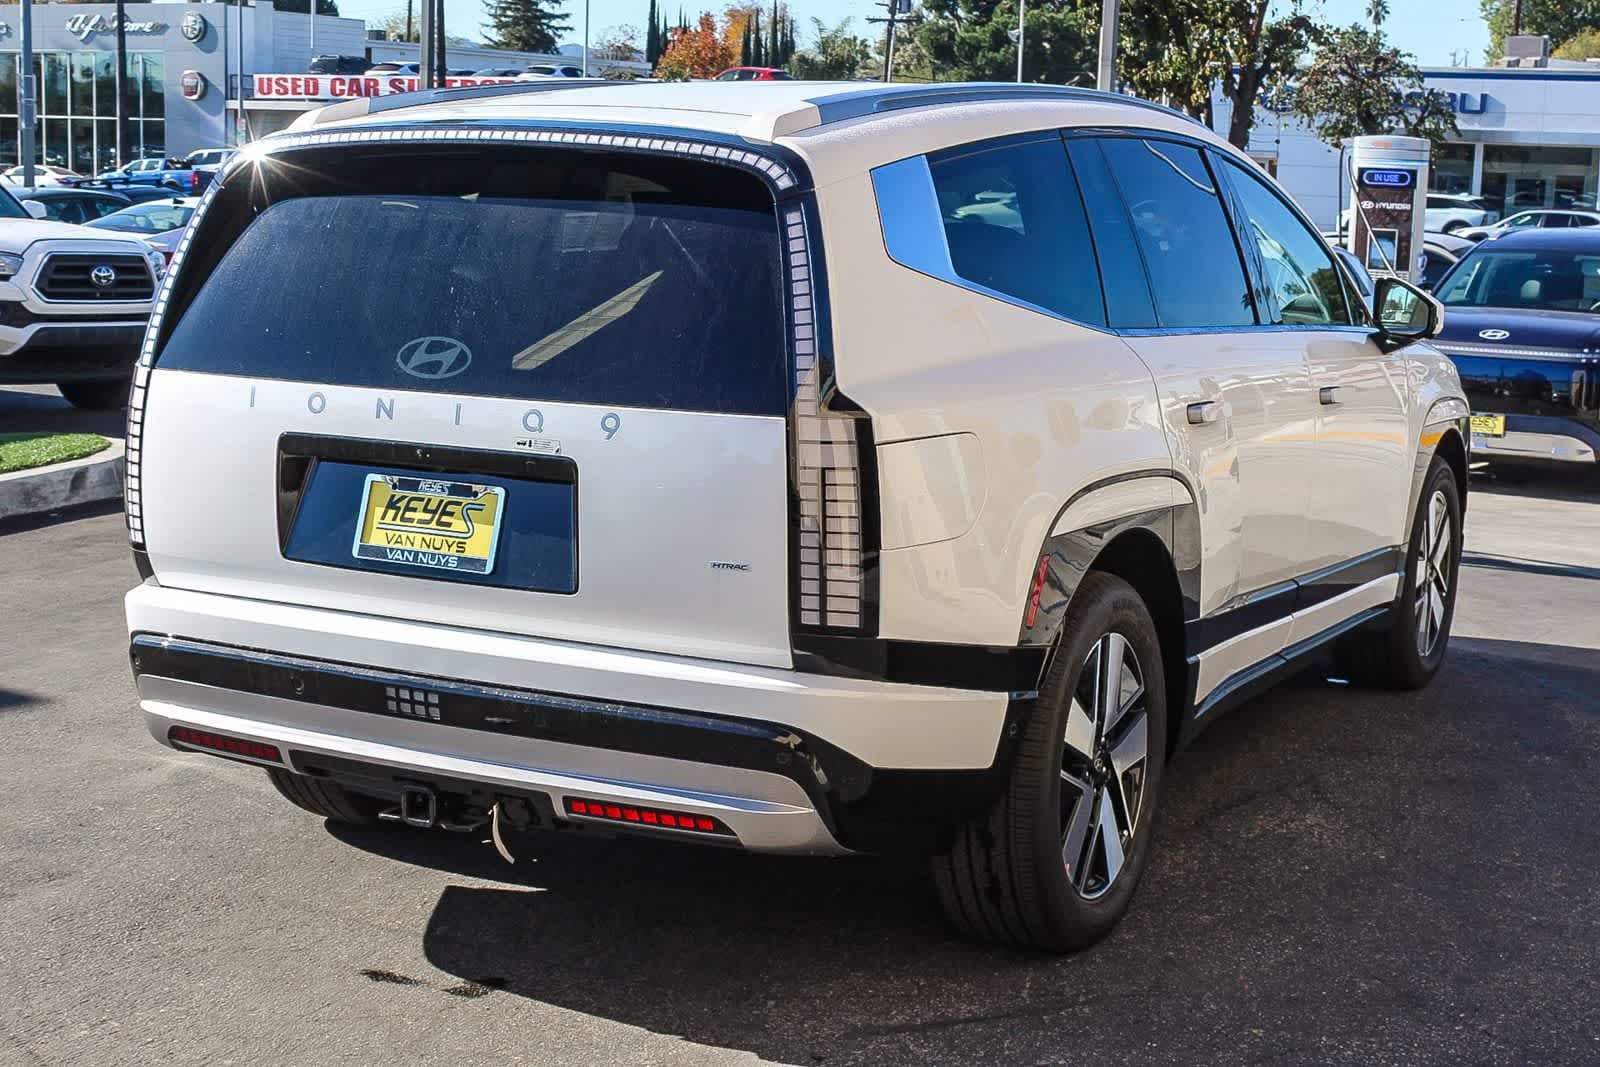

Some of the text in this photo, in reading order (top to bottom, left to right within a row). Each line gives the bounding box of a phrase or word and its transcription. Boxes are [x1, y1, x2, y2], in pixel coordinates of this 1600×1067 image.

[257, 77, 319, 96] USED
[329, 77, 380, 97] CAR
[1374, 173, 1400, 183] IN USE
[1375, 201, 1411, 211] HYUNDAI
[600, 412, 622, 440] 9
[418, 481, 450, 496] KEYES
[379, 494, 486, 539] KEYES
[385, 532, 467, 554] VAN NUYS
[386, 548, 458, 568] VAN NUYS
